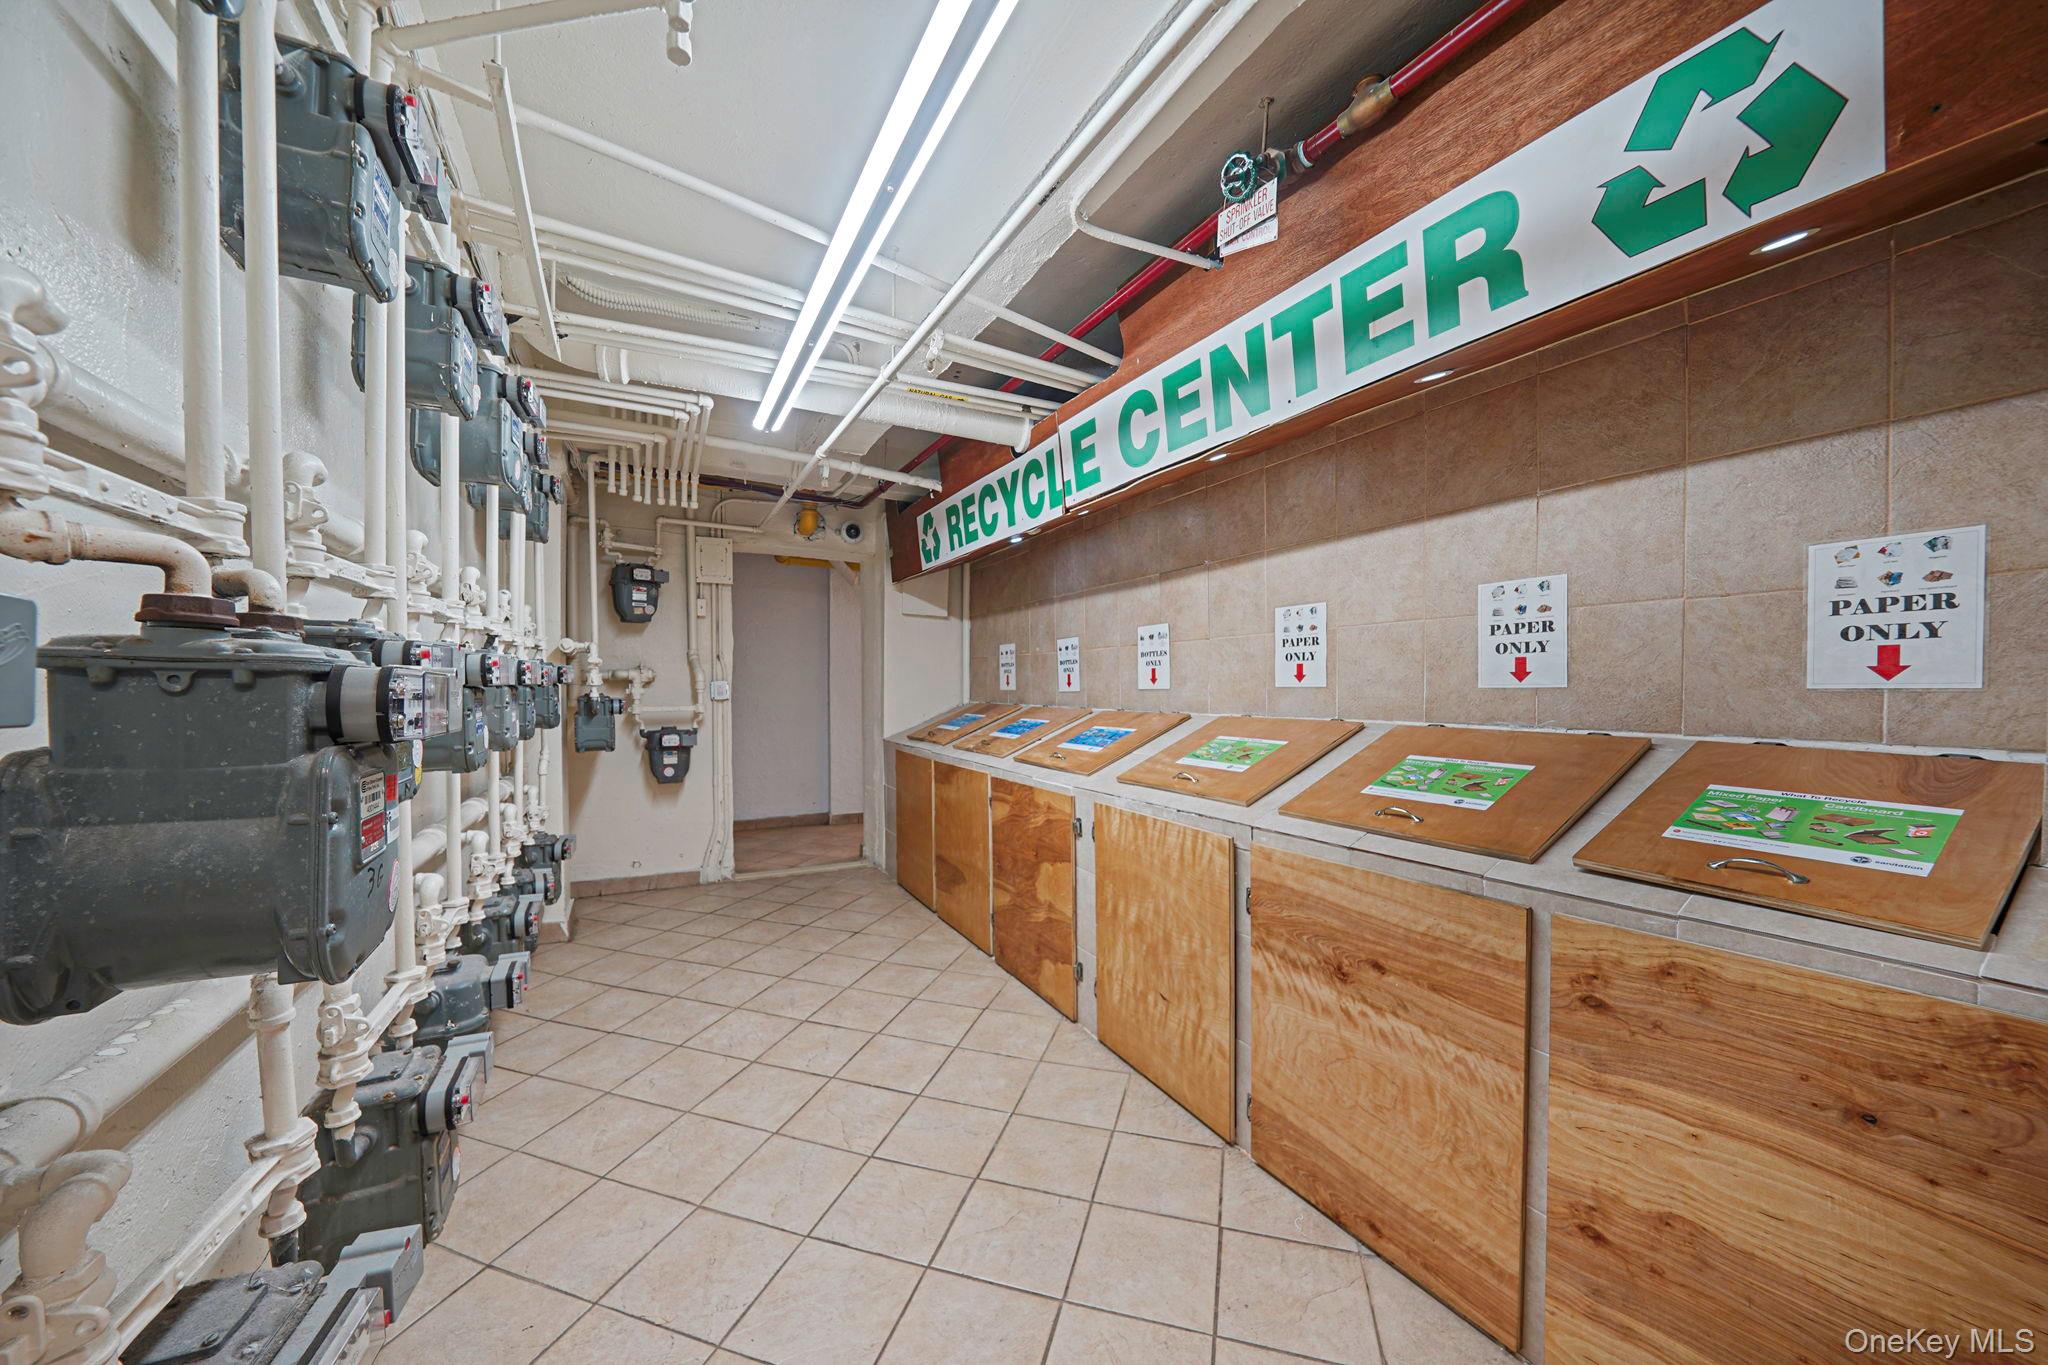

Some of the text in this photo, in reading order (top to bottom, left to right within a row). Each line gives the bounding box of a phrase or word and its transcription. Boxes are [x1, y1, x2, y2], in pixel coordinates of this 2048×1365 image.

[1226, 187, 1268, 224] SPRINKLER
[1219, 199, 1274, 242] SHUT-OFF VALVE
[946, 190, 1529, 552] RECYCLE CENTER
[908, 387, 936, 397] NATURAL
[1829, 592, 1960, 617] PAPER
[1489, 620, 1555, 636] PAPER
[1840, 621, 1948, 642] ONLY
[1282, 636, 1320, 648] PAPER
[1495, 640, 1550, 655] ONLY
[1140, 650, 1168, 658] BOTTLES
[1285, 651, 1317, 662] ONLY
[1708, 790, 1745, 799] Mixed
[1747, 795, 1784, 804] Paper
[1824, 796, 1867, 805] Recycle
[1824, 803, 1904, 816] Cardboard
[1874, 860, 1924, 871] sanitation
